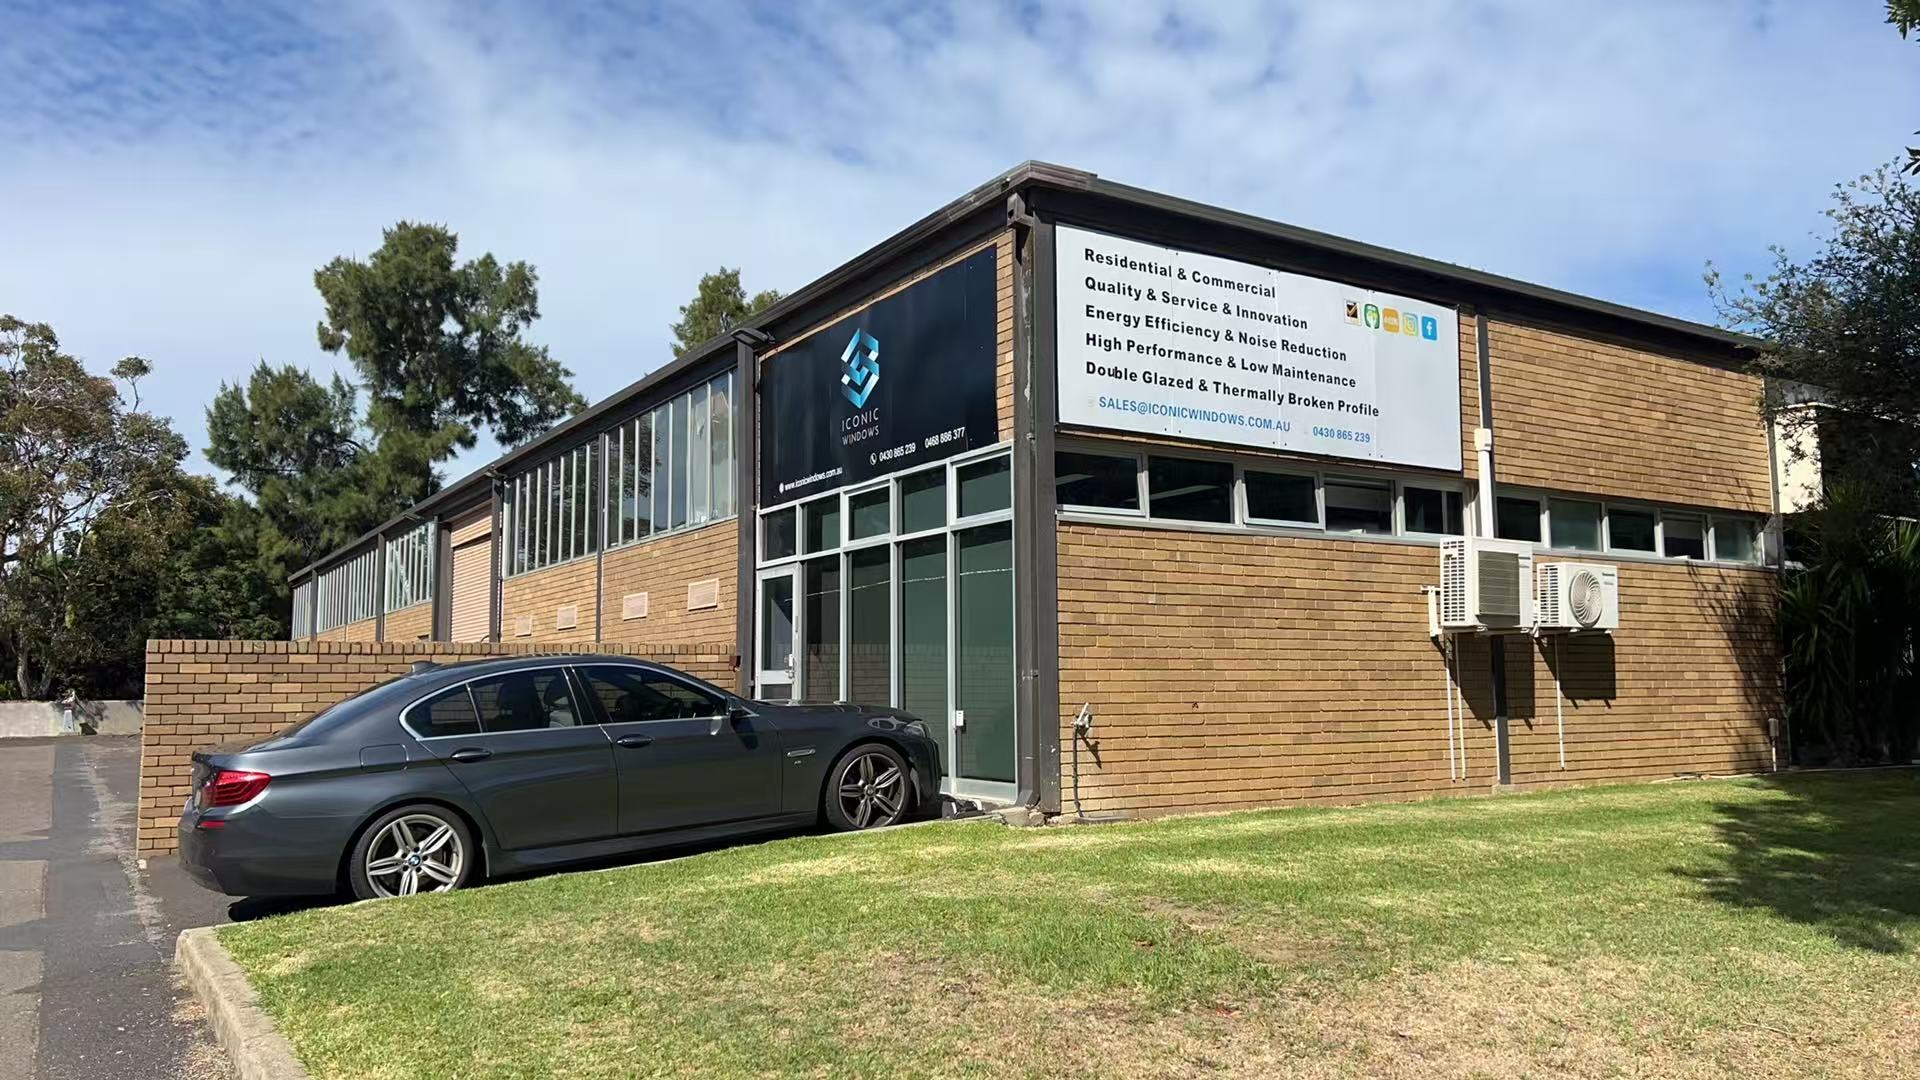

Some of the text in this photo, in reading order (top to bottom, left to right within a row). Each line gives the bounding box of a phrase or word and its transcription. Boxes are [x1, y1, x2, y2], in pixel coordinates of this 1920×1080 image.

[1085, 248, 1275, 298] Residential & Commercial
[1085, 277, 1307, 329] Quality & Service & Innovation
[1086, 304, 1346, 361] Energy Efficiency & Noise Reduction
[1086, 333, 1356, 387] High Performance & Low Maintenance
[1086, 361, 1379, 416] Double Glazed & Thermally Broken Profile
[841, 407, 879, 432] ICONIC
[1099, 397, 1290, 432] SALES@ICONICWINDOWS.COM.AU
[842, 425, 880, 446] WINDOWS
[1313, 426, 1370, 442] 0430 865 239
[879, 442, 916, 462] 0430 865 239
[785, 467, 843, 491] www.iconicwindows.com.au
